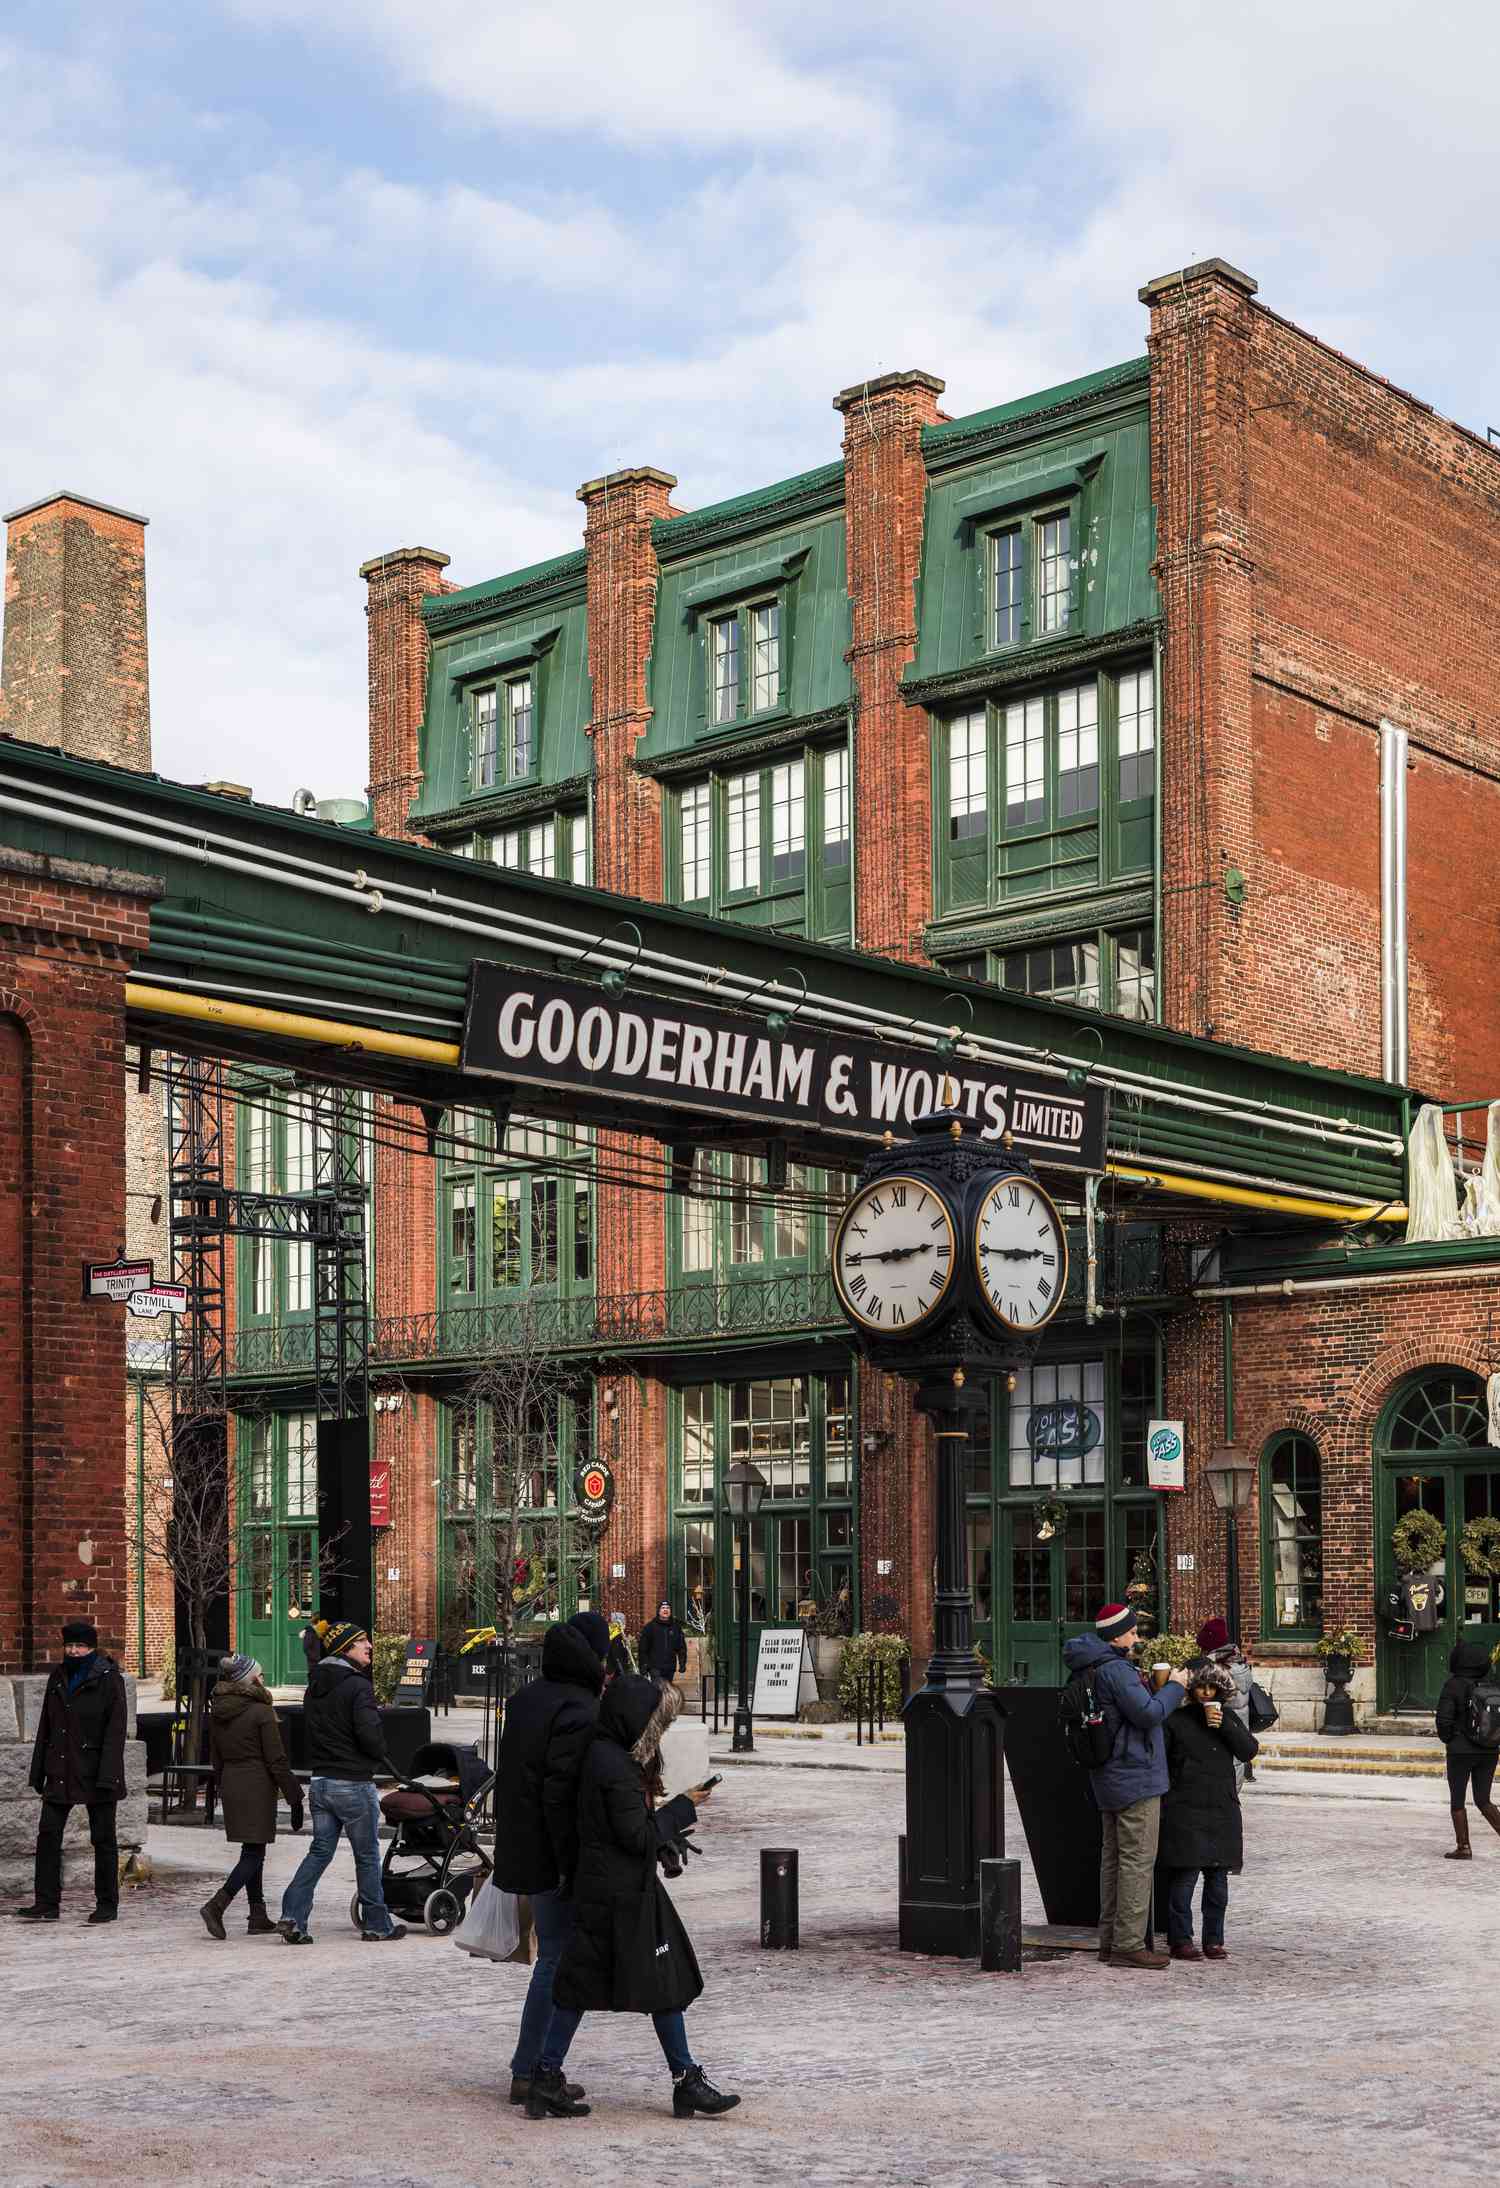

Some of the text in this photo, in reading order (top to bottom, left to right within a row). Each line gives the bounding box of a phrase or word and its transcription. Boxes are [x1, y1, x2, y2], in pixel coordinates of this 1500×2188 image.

[499, 992, 816, 1107] GOODERHAM
[825, 1055, 858, 1116] &
[1011, 1101, 1083, 1140] LIMITED
[892, 1186, 906, 1208] XII
[1008, 1186, 1019, 1208] XII
[868, 1196, 884, 1219] XI
[851, 1222, 867, 1238] X
[105, 1278, 135, 1291] TRINITY
[156, 1289, 182, 1297] DISTRICT
[129, 1294, 173, 1310] ISTMILL
[138, 1307, 153, 1315] LANE
[1152, 1434, 1177, 1460] FASS
[1466, 1590, 1486, 1600] OPEN
